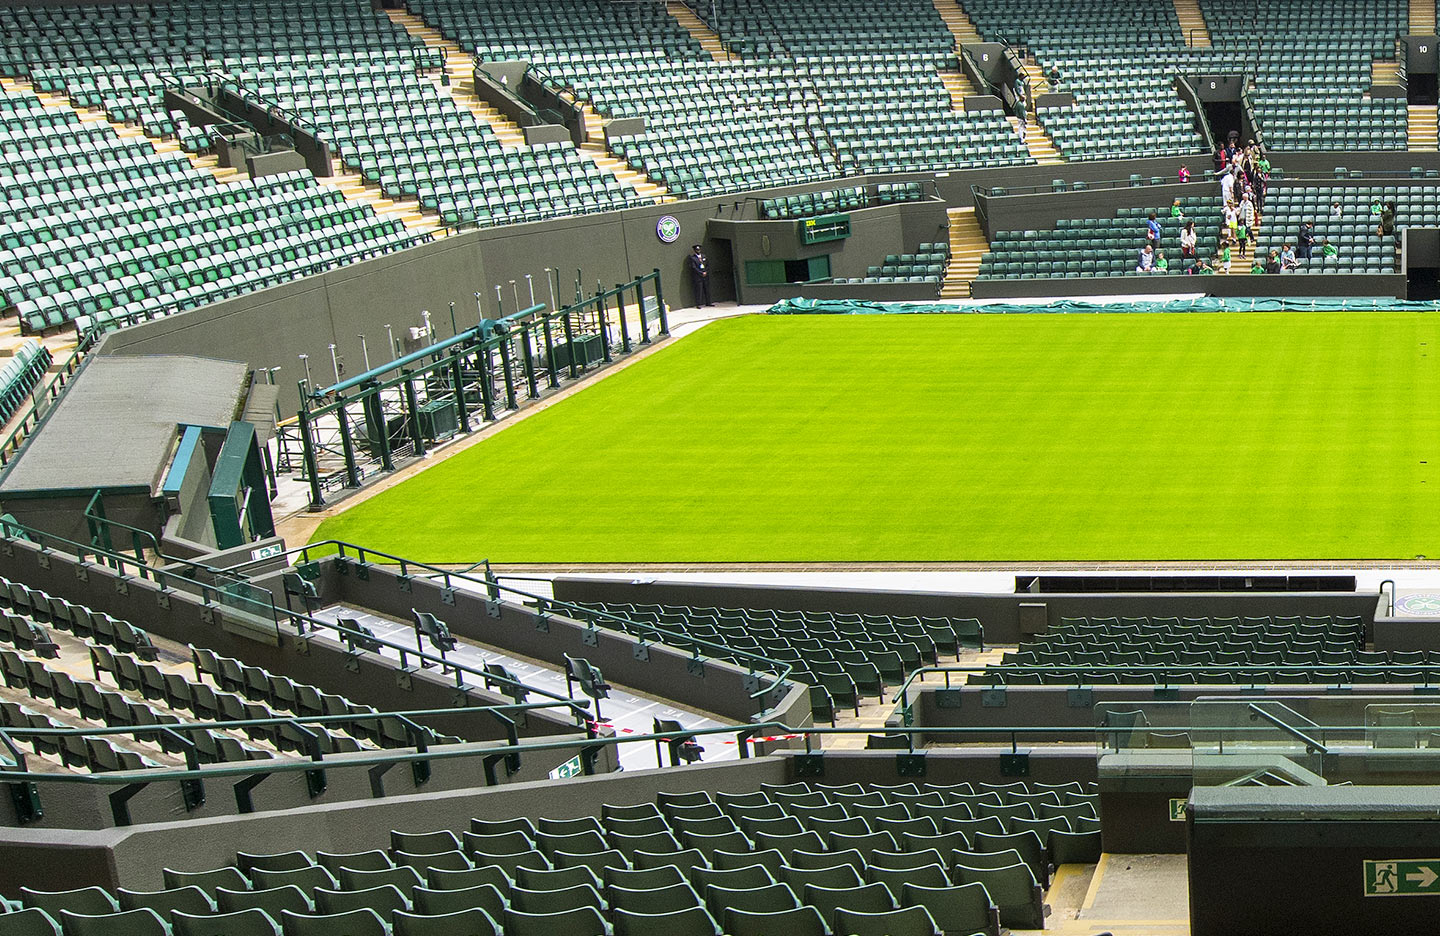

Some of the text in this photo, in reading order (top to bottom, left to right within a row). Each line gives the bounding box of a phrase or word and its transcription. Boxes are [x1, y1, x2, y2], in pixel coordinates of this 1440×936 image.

[1419, 45, 1428, 53] 10
[501, 75, 508, 84] 4
[1210, 81, 1216, 89] 8
